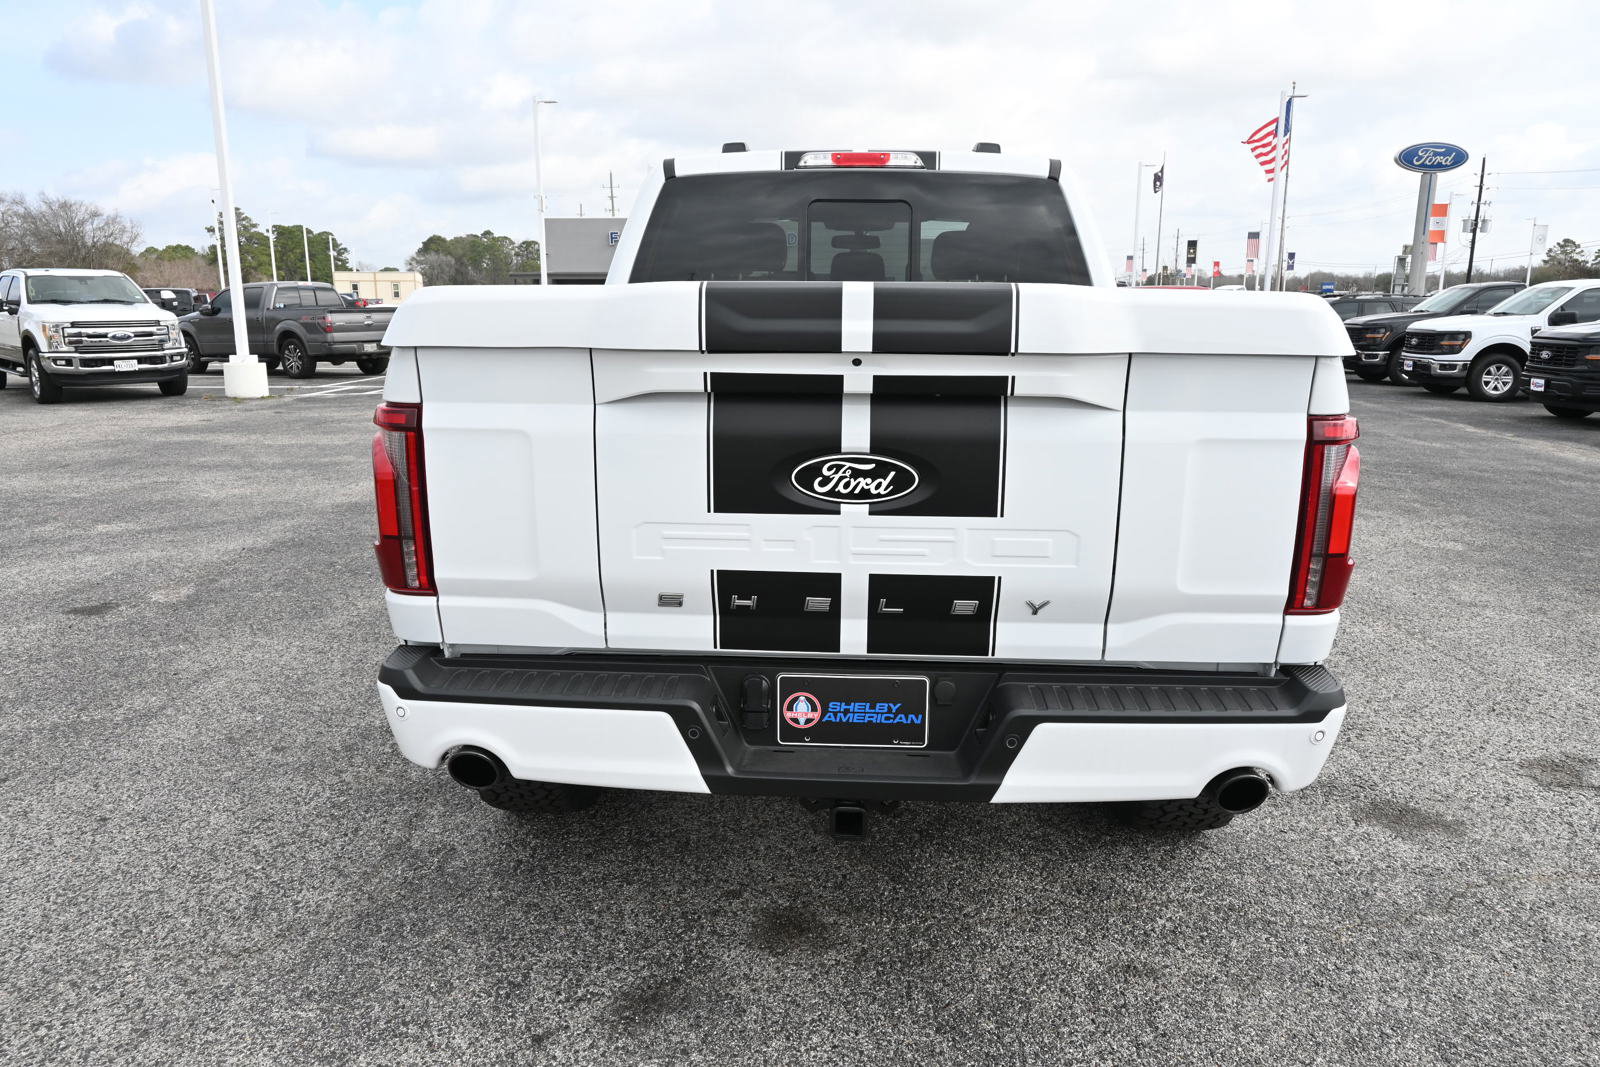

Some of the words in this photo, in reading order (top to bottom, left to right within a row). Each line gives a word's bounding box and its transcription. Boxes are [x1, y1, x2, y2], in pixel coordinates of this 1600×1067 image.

[1413, 147, 1456, 166] Ford
[813, 460, 897, 495] Ford
[631, 522, 1081, 567] F-150
[826, 701, 902, 714] SHELBY
[821, 713, 923, 724] AMERICAN
